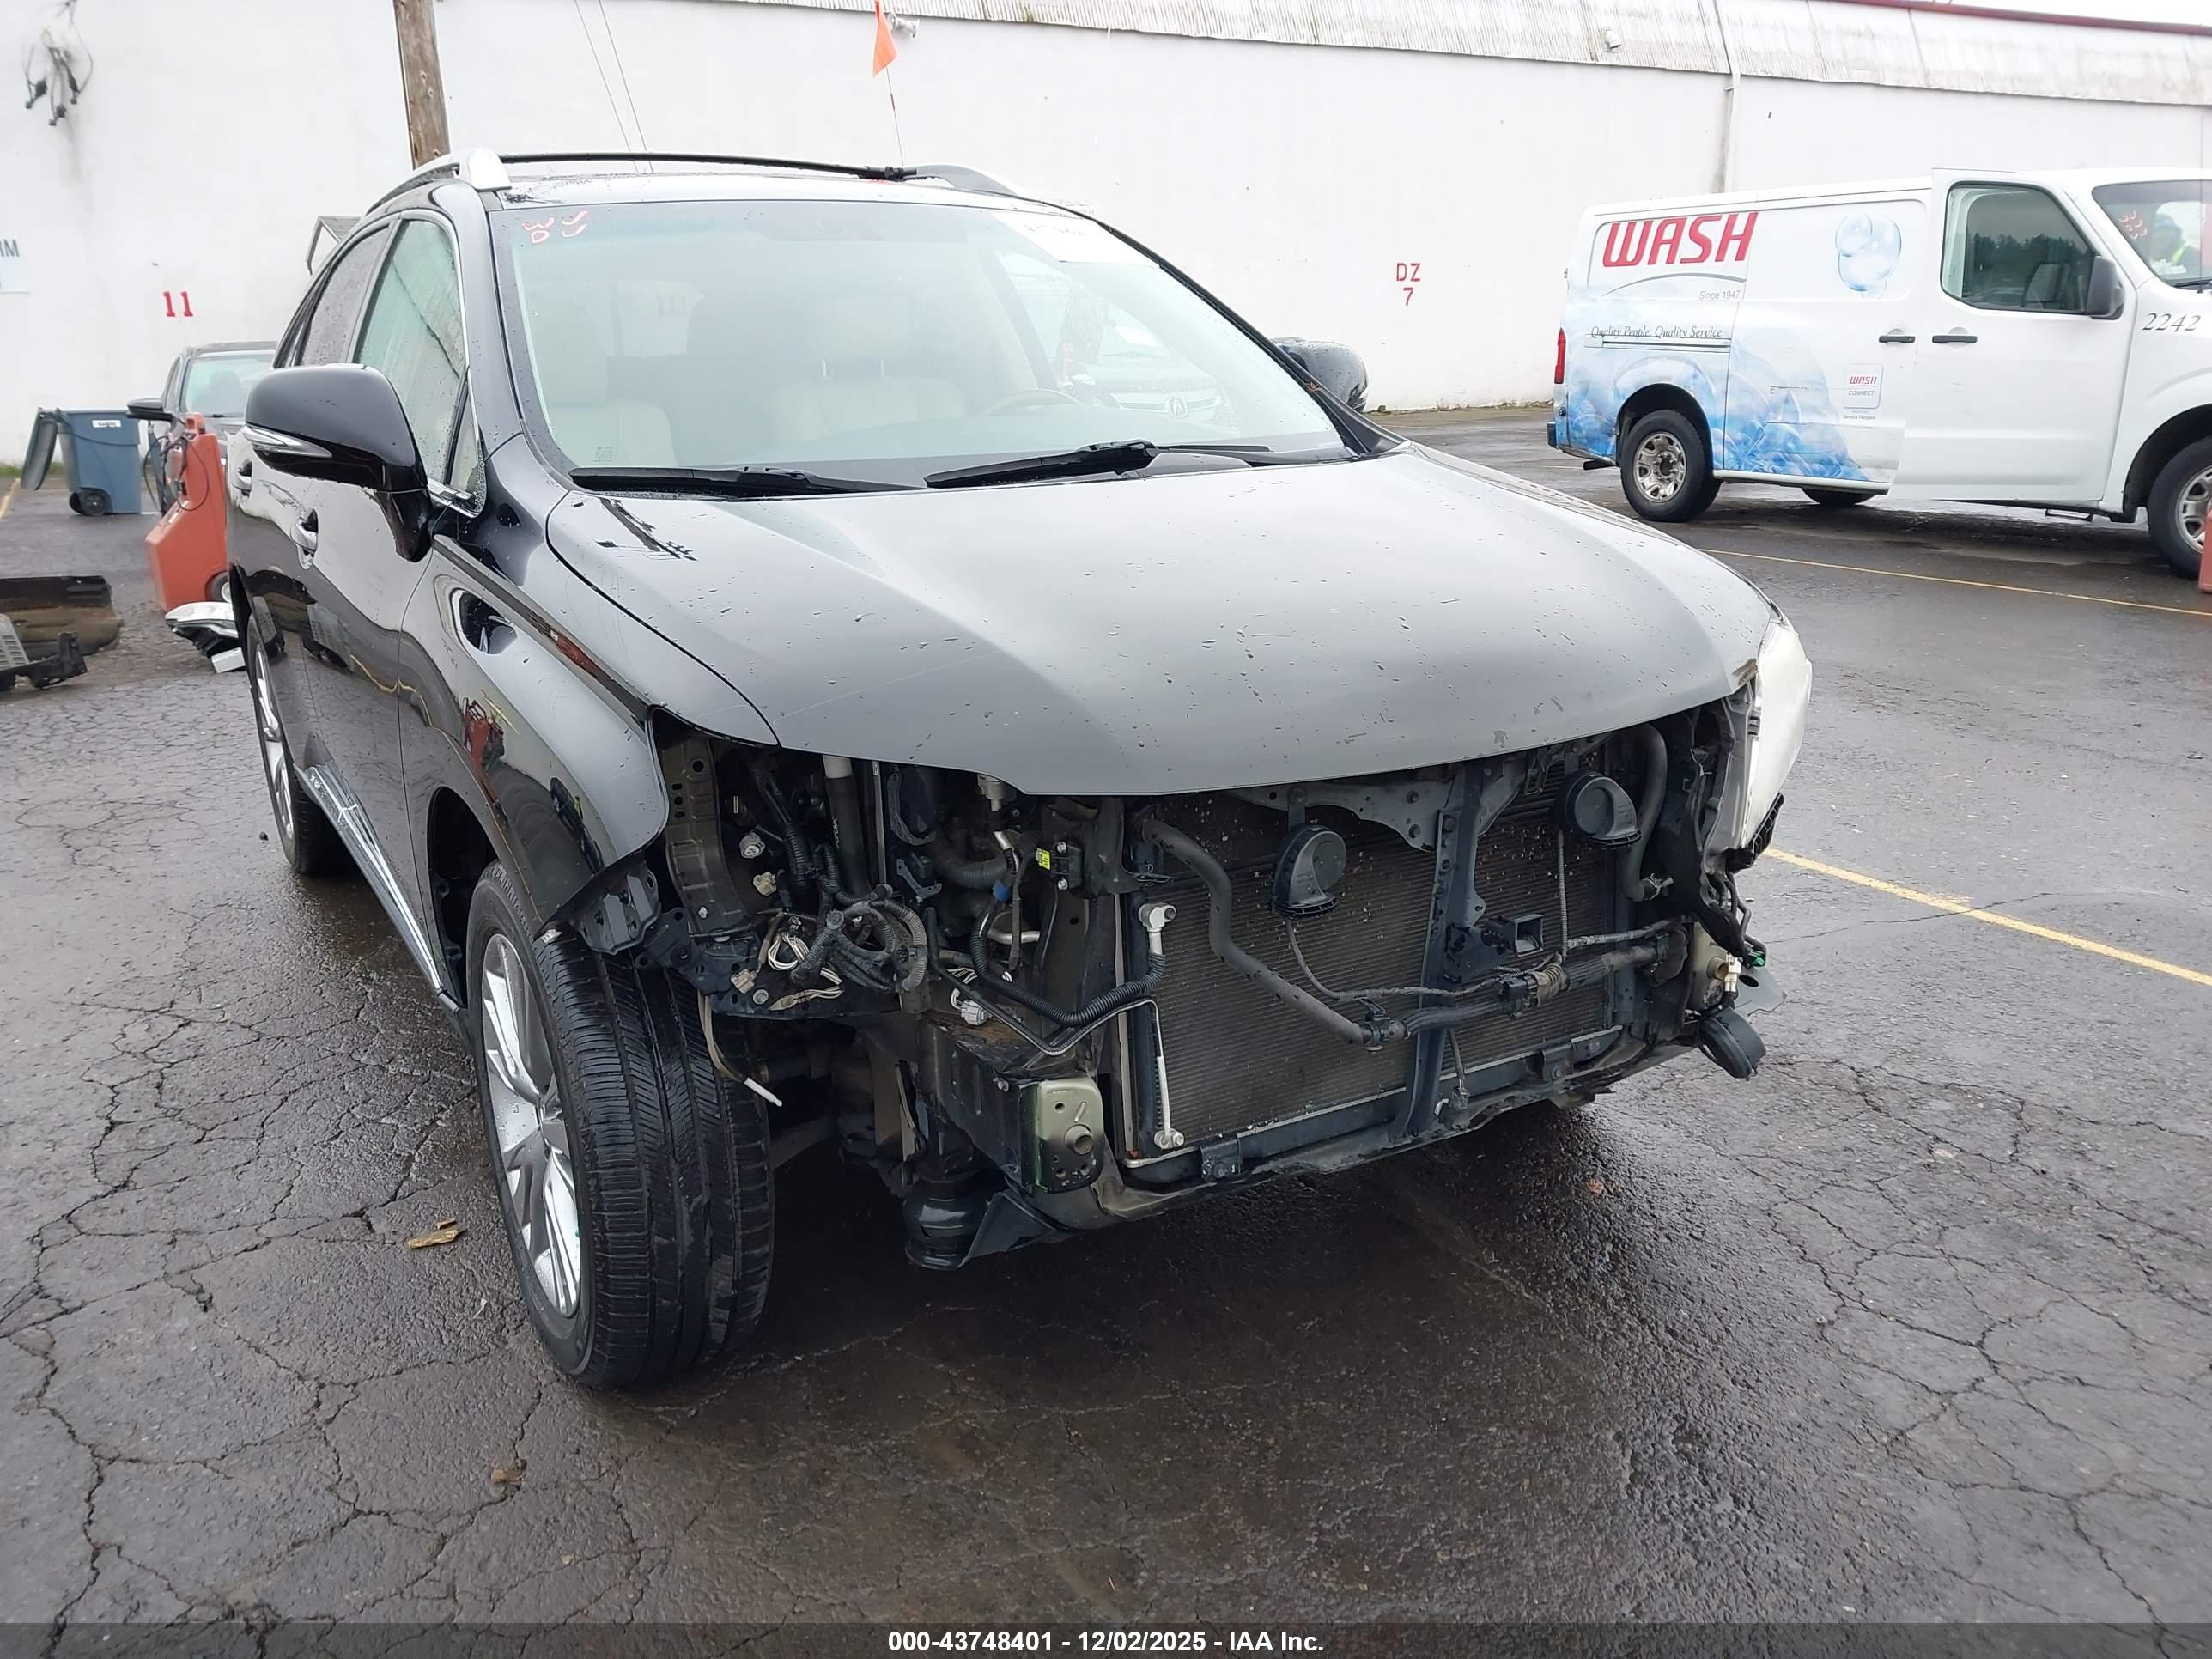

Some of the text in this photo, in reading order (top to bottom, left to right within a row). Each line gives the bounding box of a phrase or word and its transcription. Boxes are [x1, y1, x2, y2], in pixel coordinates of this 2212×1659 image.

[1602, 212, 1759, 267] WASH
[1396, 263, 1421, 282] DZ
[163, 291, 193, 317] 11
[1403, 287, 1413, 306] 7
[1699, 290, 1741, 300] Since 1947
[1590, 325, 1621, 338] Quality
[1655, 326, 1688, 338] Quality
[1690, 326, 1723, 337] Service
[2142, 313, 2201, 332] 2242
[1849, 376, 1878, 385] WASH
